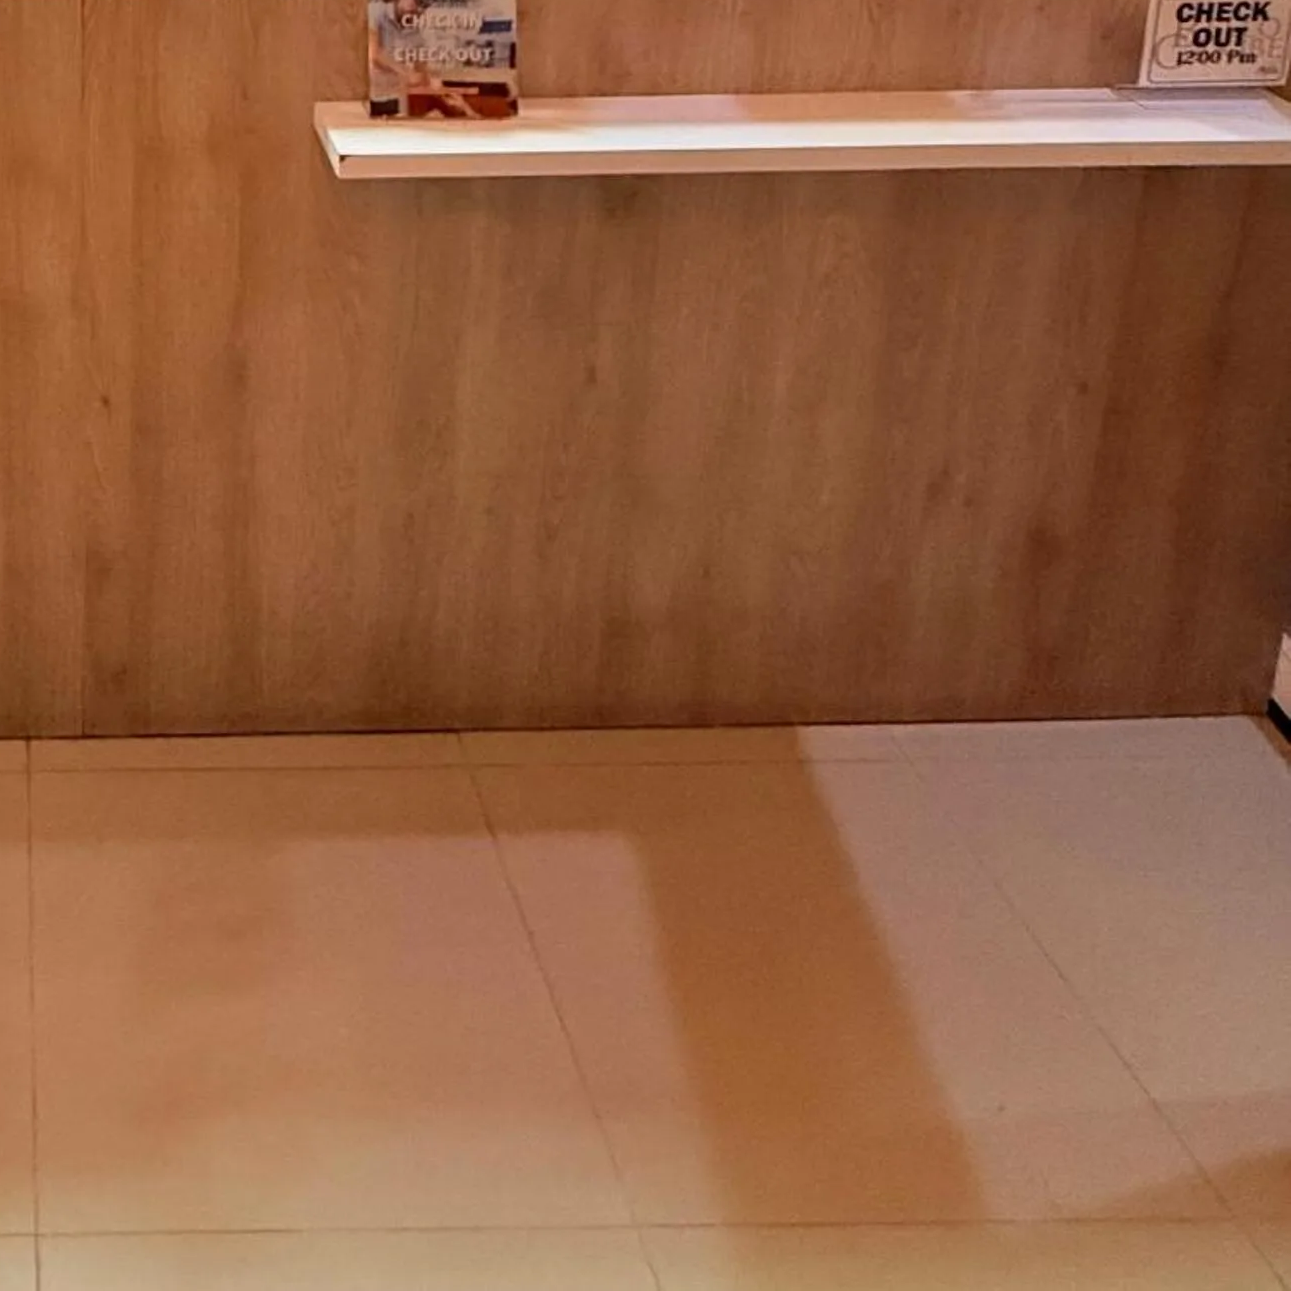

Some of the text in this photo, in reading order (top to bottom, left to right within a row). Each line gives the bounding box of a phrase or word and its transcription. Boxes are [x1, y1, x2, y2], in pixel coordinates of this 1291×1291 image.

[1176, 1, 1272, 24] CHECK
[1192, 27, 1249, 48] OUT
[395, 48, 492, 62] CHECK OUT
